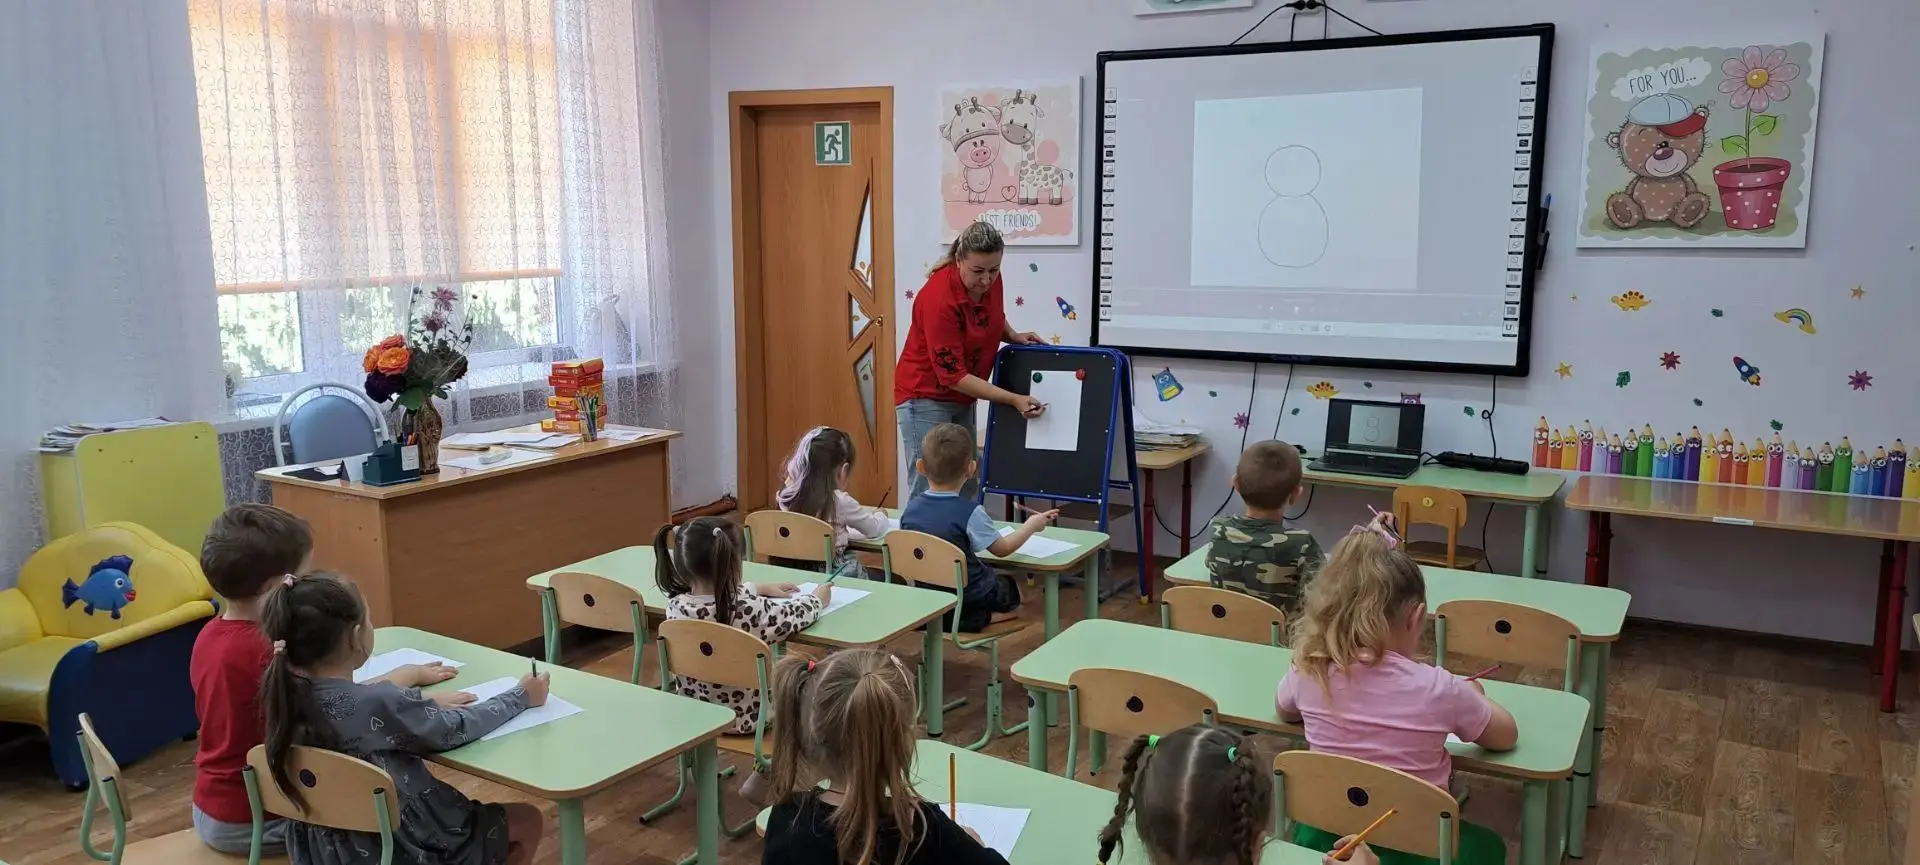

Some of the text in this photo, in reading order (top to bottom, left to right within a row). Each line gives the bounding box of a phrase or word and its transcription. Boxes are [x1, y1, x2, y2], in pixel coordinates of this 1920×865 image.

[1629, 66, 1697, 94] FOR YOU...
[1003, 213, 1037, 229] FRIENDS!
